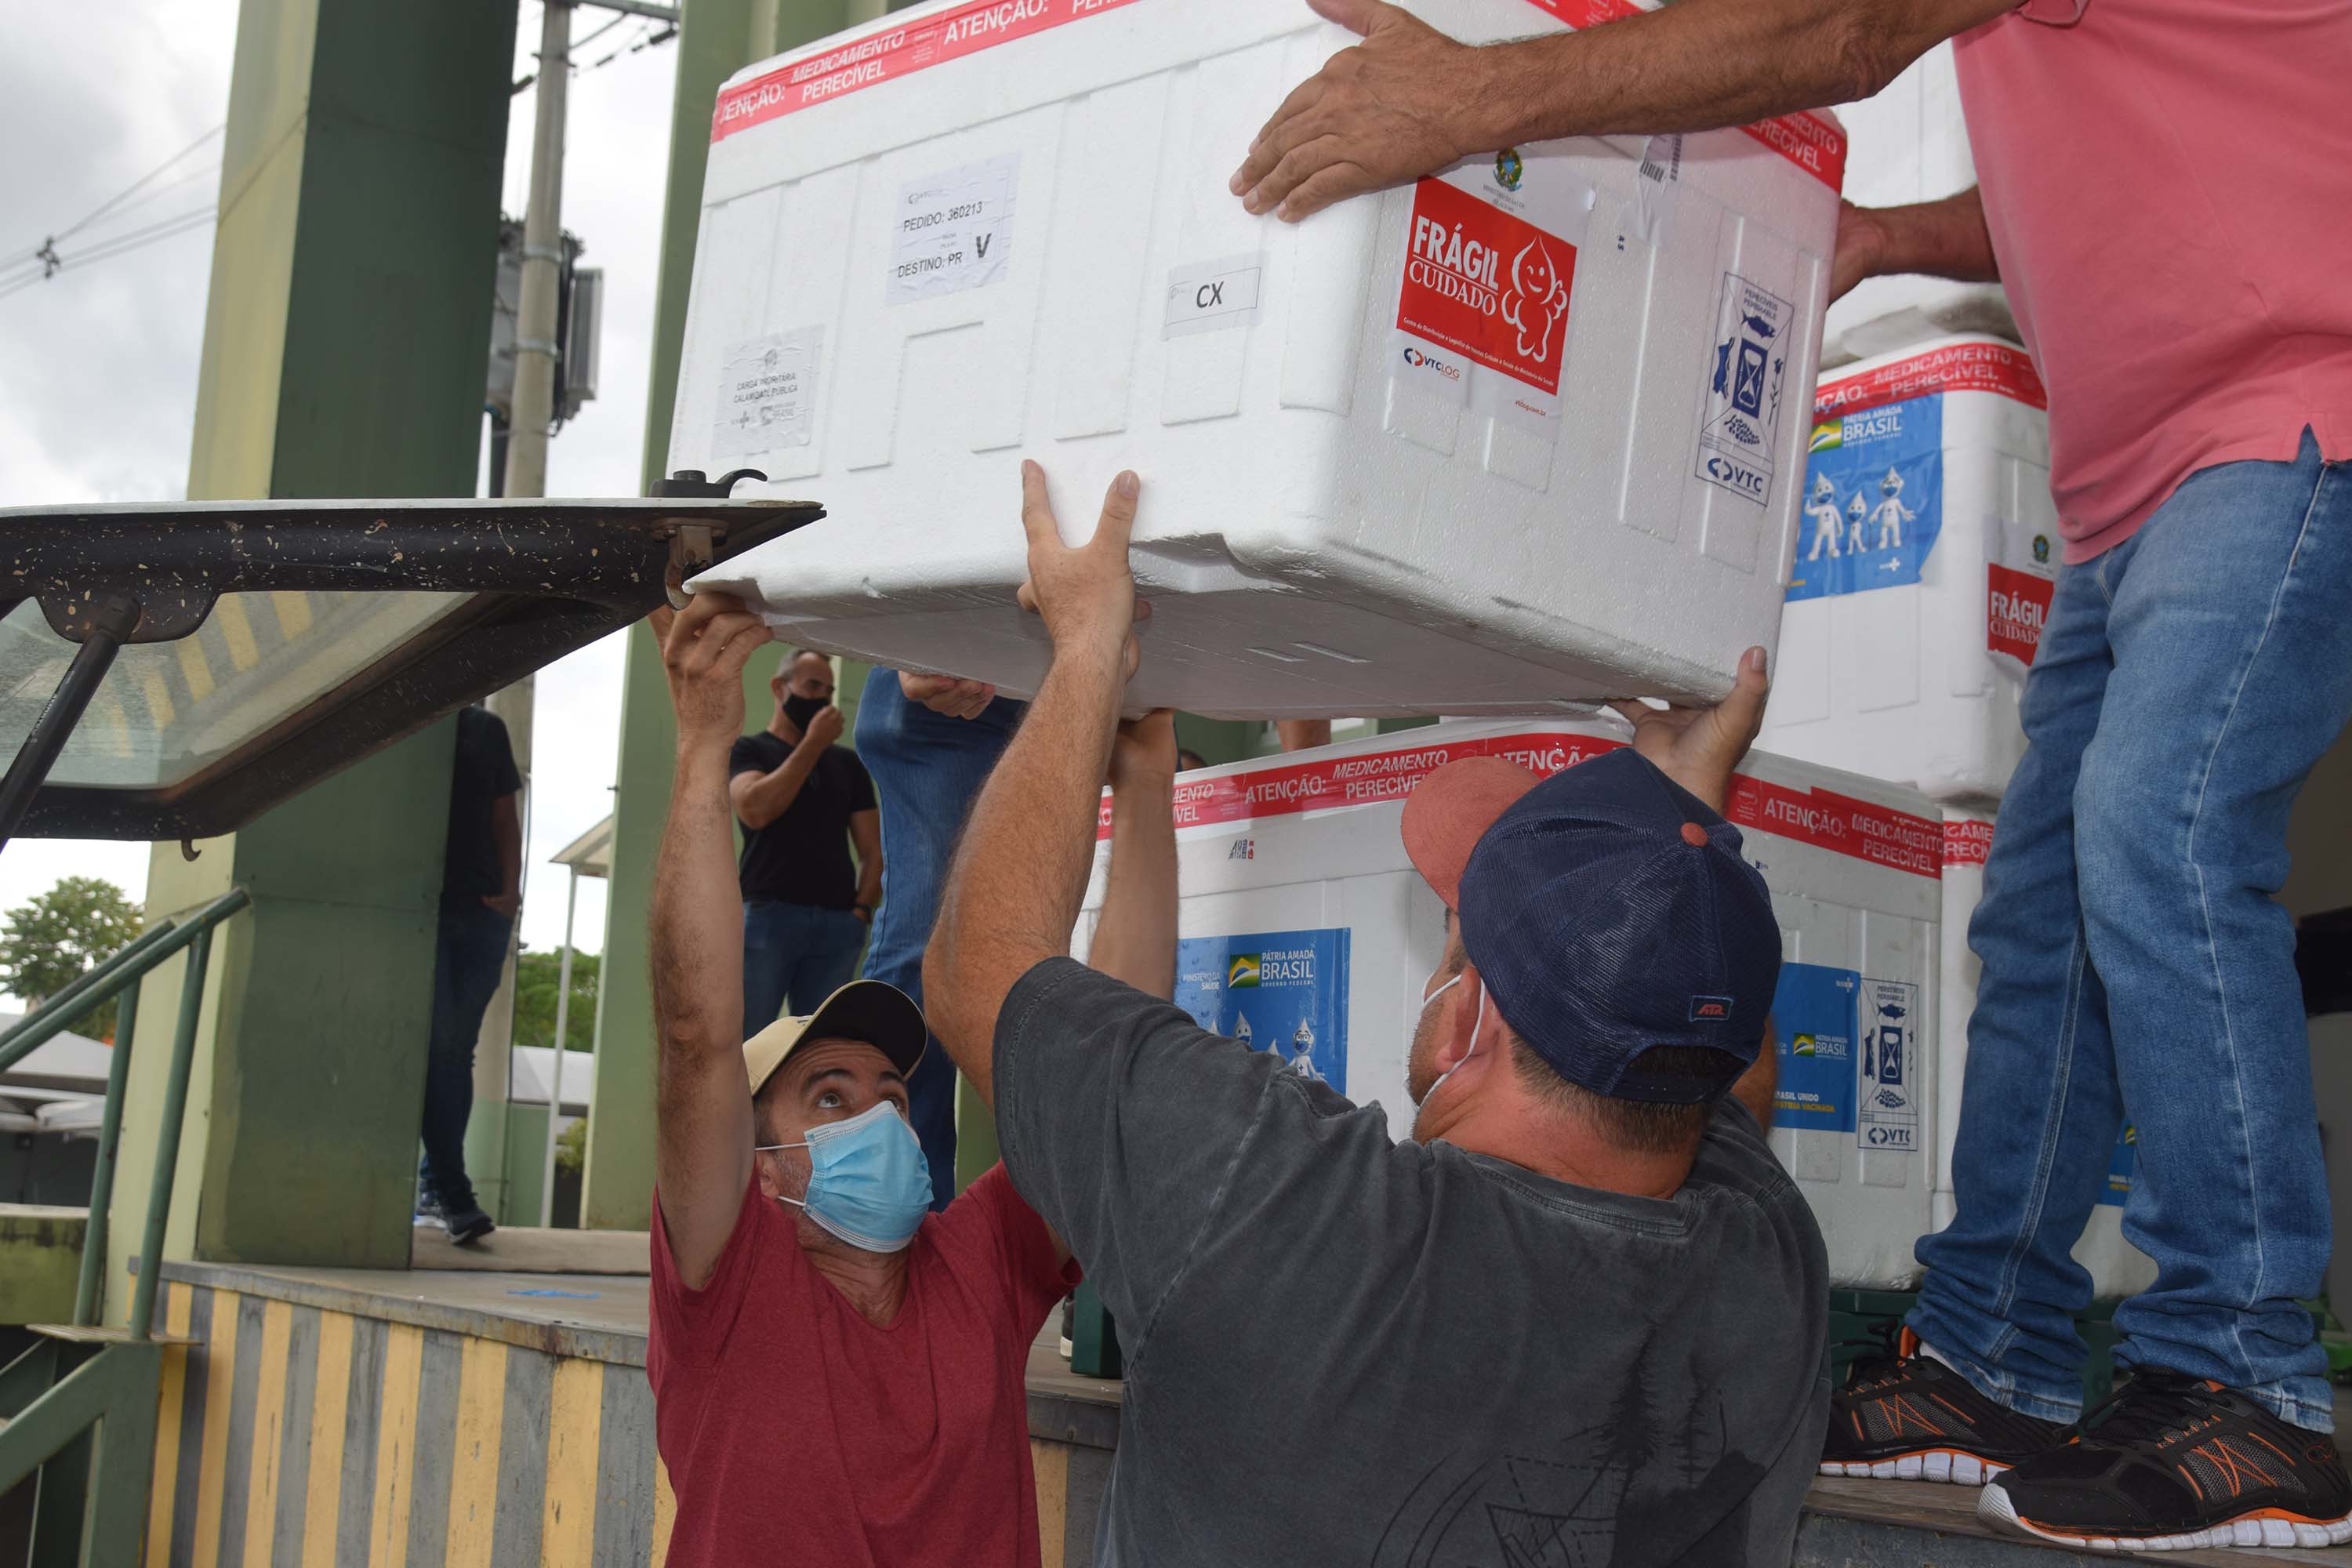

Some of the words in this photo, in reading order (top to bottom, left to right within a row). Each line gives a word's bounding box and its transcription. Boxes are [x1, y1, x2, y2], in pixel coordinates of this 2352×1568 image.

[791, 31, 906, 84] MEDICAMENTO
[803, 59, 886, 103] PERECÍVEL
[903, 211, 946, 232] PEDIDO:
[947, 201, 983, 222] 360213
[976, 233, 992, 259] V
[1413, 214, 1499, 290] FRÁGIL
[898, 256, 946, 278] DESTINO:
[948, 252, 964, 267] PR
[1196, 281, 1225, 308] CX
[1409, 260, 1497, 316] CUIDADO
[1425, 356, 1461, 379] VTCLOG
[1875, 345, 2013, 385] MEDICAMENTO
[1891, 363, 1999, 396] PERECÍVEL
[1843, 413, 1903, 441] BRASIL
[1734, 465, 1764, 493] VTC
[1991, 590, 2045, 629] FRÁGIL
[1991, 619, 2039, 644] CUIDAD
[1333, 749, 1449, 779] MEDICAMENTO
[1245, 772, 1327, 804] ATENÇÃO:
[1345, 771, 1427, 800] PERECÍVE
[1764, 797, 1847, 838] ATENÇÃO:
[1852, 813, 1944, 854] MEDICAMENTO
[1863, 839, 1936, 873] PERECÍVEL
[1262, 949, 1287, 962] PÁTRIA
[1287, 949, 1315, 960] AMADA
[1261, 961, 1314, 981] BRASIL
[1816, 1042, 1848, 1056] BRASIL
[1889, 1129, 1911, 1142] VTC
